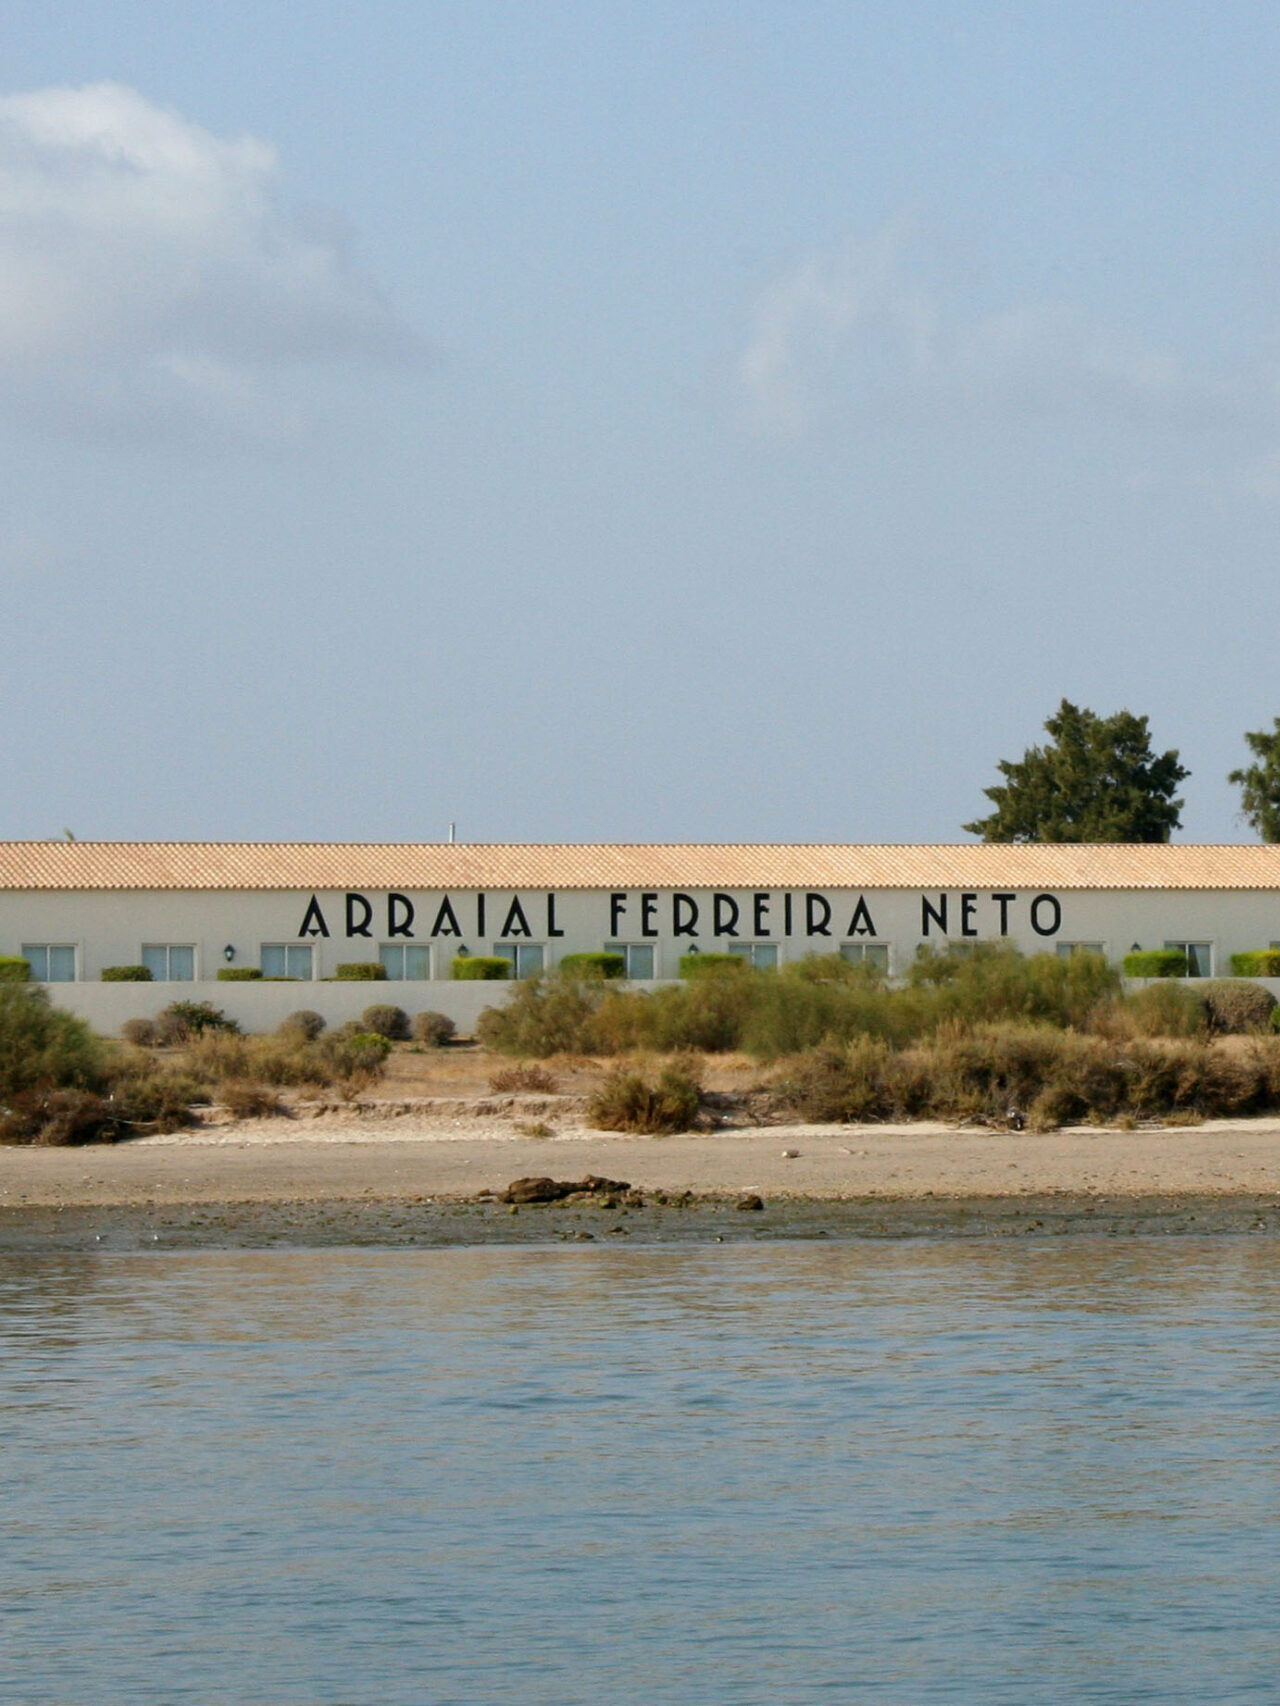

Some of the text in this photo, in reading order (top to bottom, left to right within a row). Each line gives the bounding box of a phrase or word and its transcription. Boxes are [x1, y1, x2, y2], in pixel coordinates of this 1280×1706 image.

[297, 892, 1062, 938] ARRAIAL FERREIRA NETO
